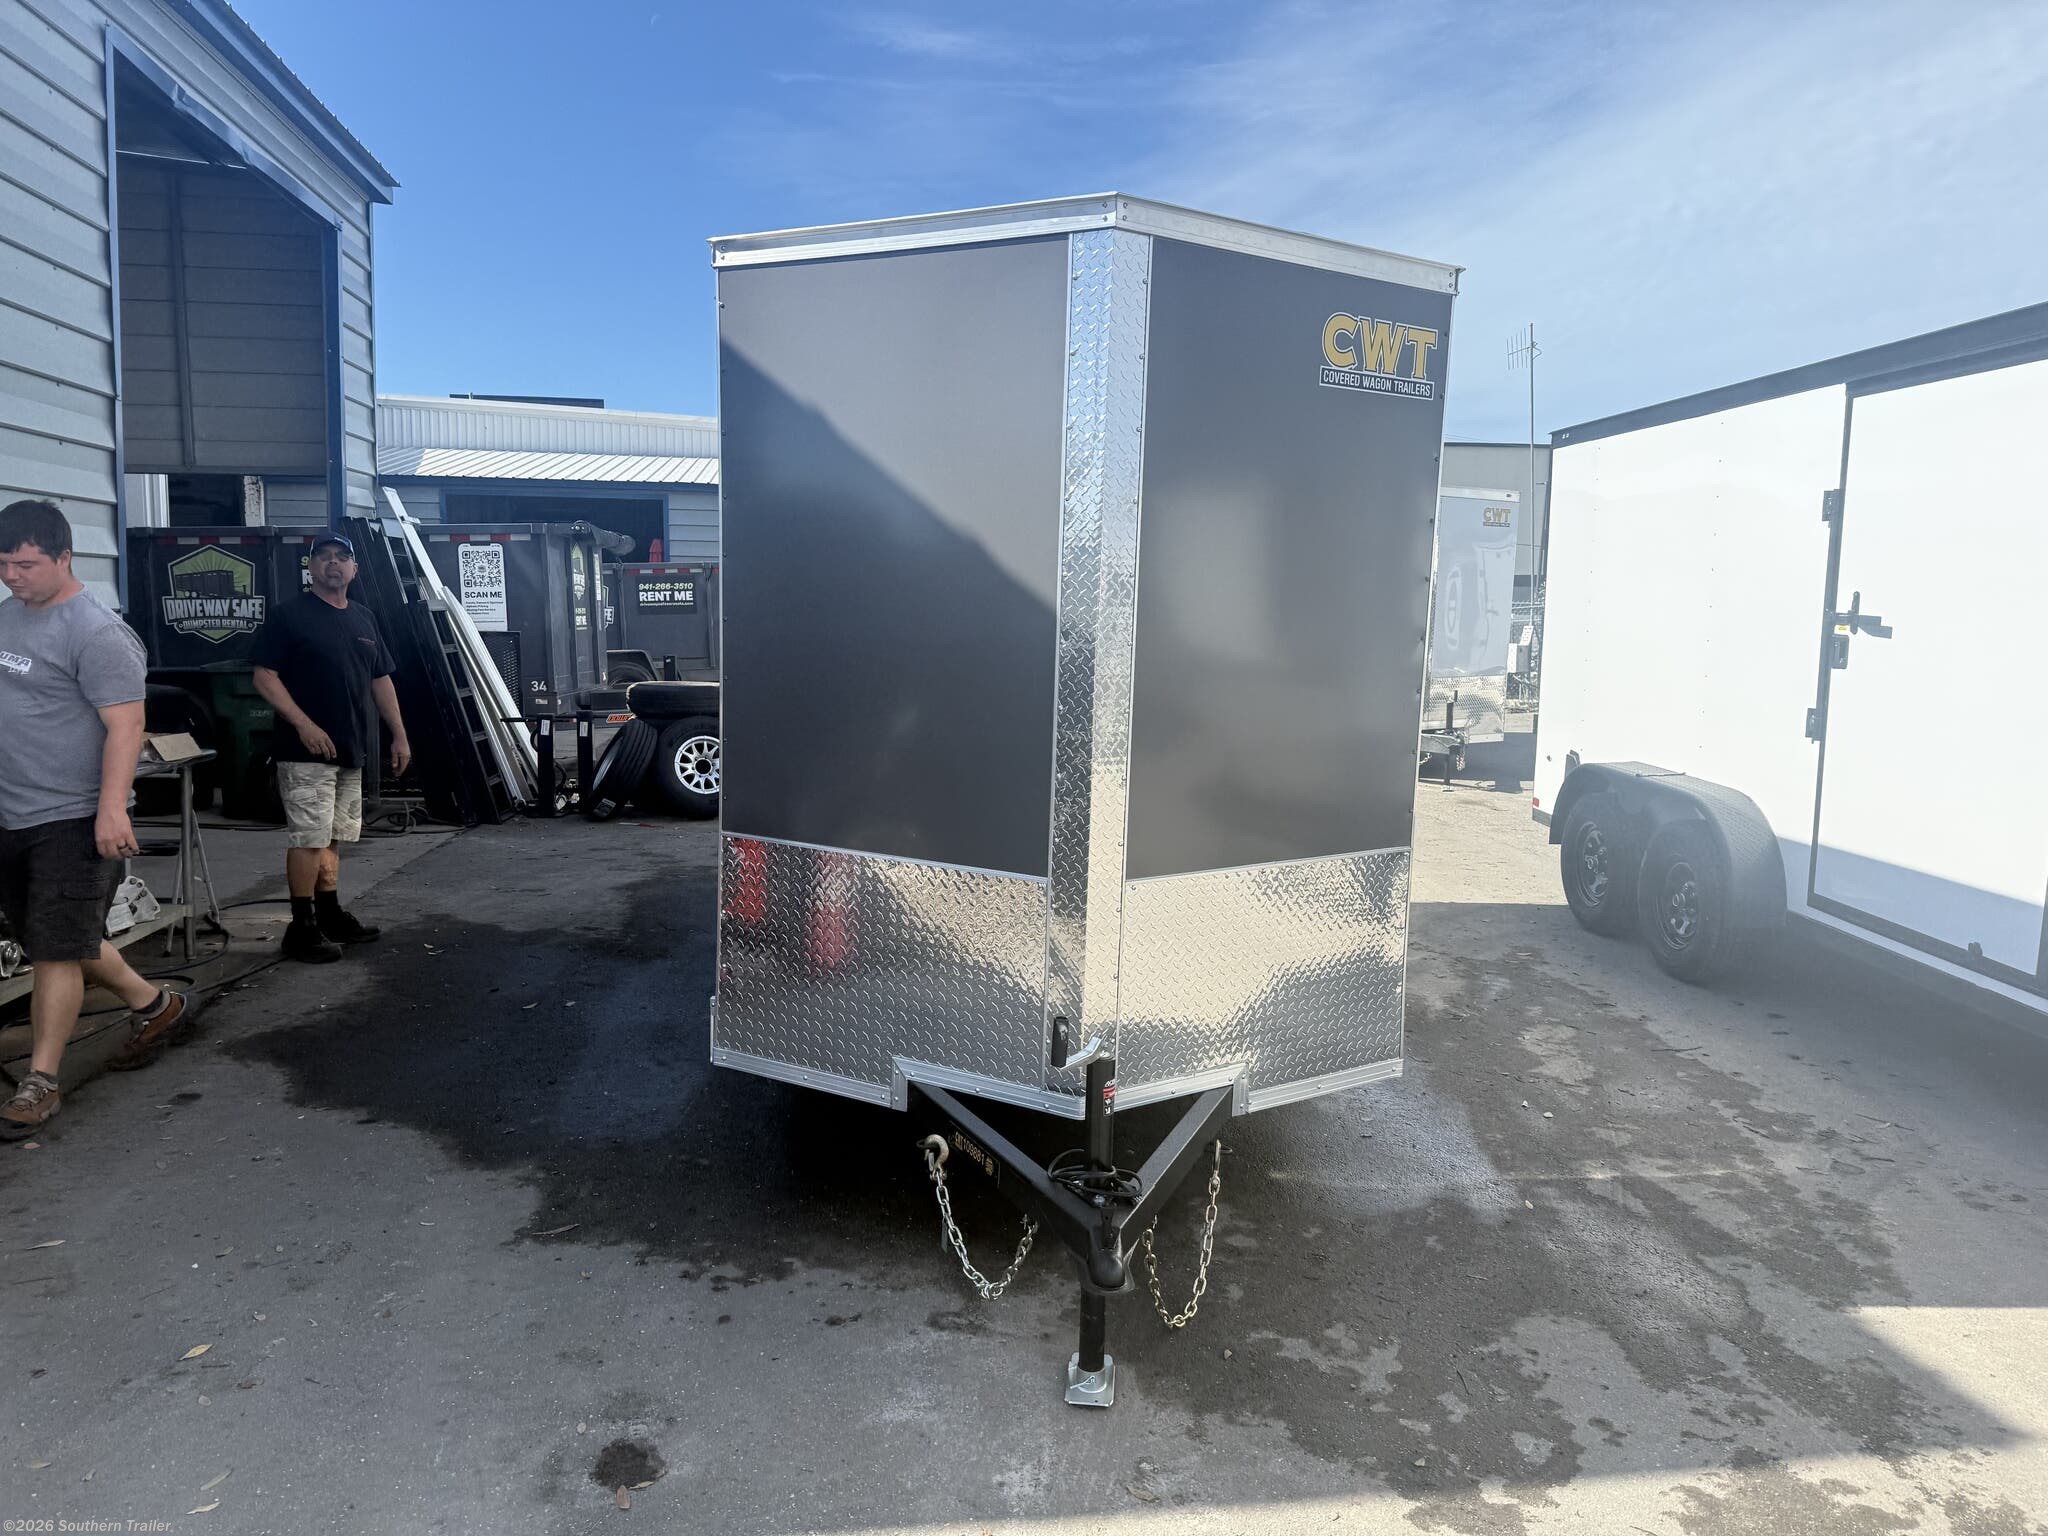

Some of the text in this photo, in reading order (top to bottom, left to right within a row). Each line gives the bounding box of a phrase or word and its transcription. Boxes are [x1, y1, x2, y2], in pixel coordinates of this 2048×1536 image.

[1322, 312, 1438, 380] CWT
[1323, 370, 1431, 397] COVERED WAGON TRAILERS
[1483, 506, 1511, 523] CWT
[464, 591, 503, 599] SCAN ME
[639, 591, 694, 602] RENT ME
[166, 598, 263, 620] DRIVEWAY SAFE
[182, 619, 248, 629] DUMPSTER RENTAL
[531, 680, 548, 692] 34
